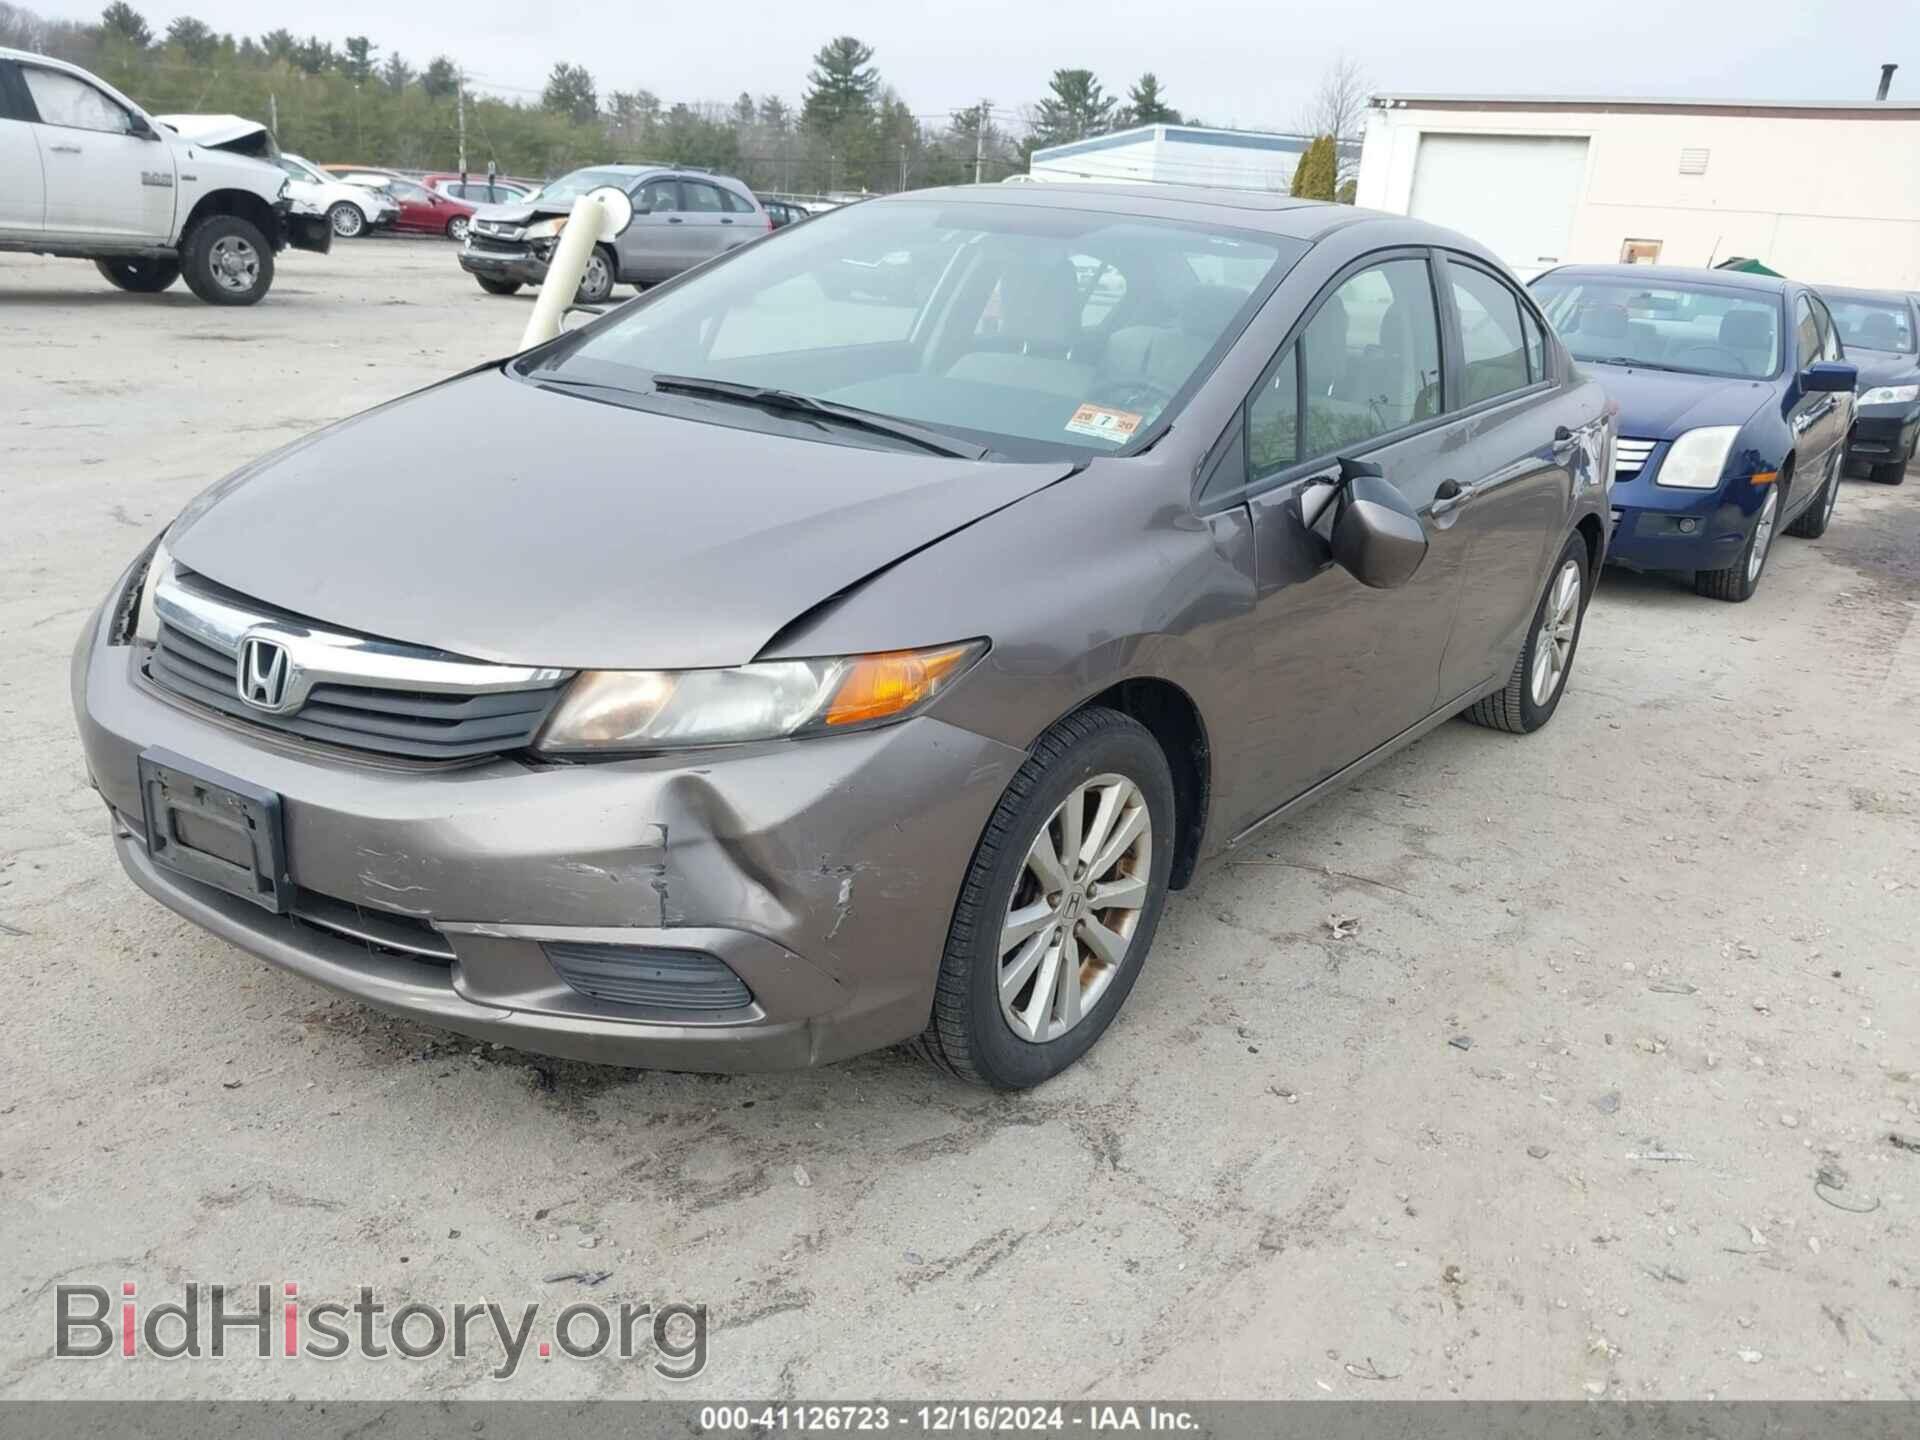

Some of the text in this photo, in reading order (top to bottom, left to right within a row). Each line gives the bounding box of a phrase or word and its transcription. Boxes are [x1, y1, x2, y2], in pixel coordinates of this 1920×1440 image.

[1077, 411, 1134, 430] 20 7 20
